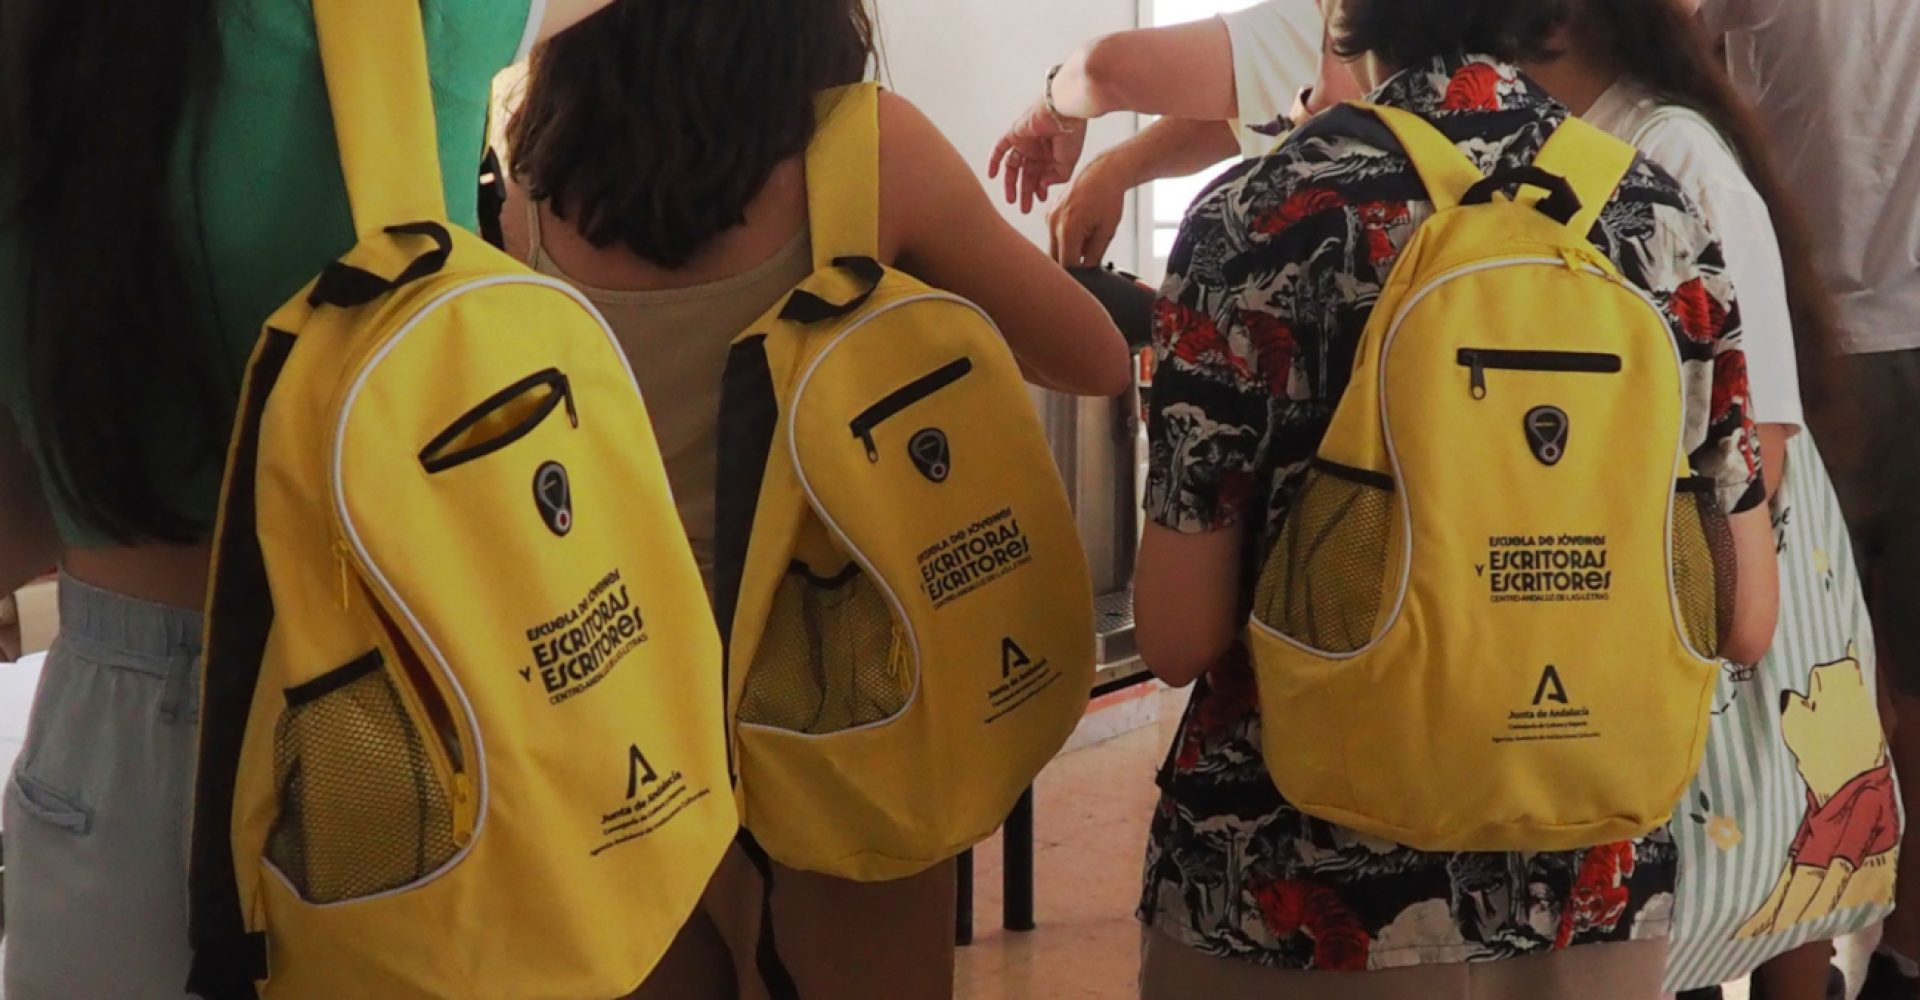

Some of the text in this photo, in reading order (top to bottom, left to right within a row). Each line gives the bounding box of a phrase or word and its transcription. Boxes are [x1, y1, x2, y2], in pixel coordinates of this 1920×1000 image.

[921, 518, 1019, 582] ESCRITORAS
[1489, 550, 1607, 570] ESCRITORAS
[1474, 564, 1485, 577] Y
[532, 584, 630, 669] ESCRITORAS
[518, 666, 530, 682] Y
[1508, 706, 1589, 719] Junta de Andalucía
[601, 806, 632, 824] Junta
[633, 799, 646, 812] de
